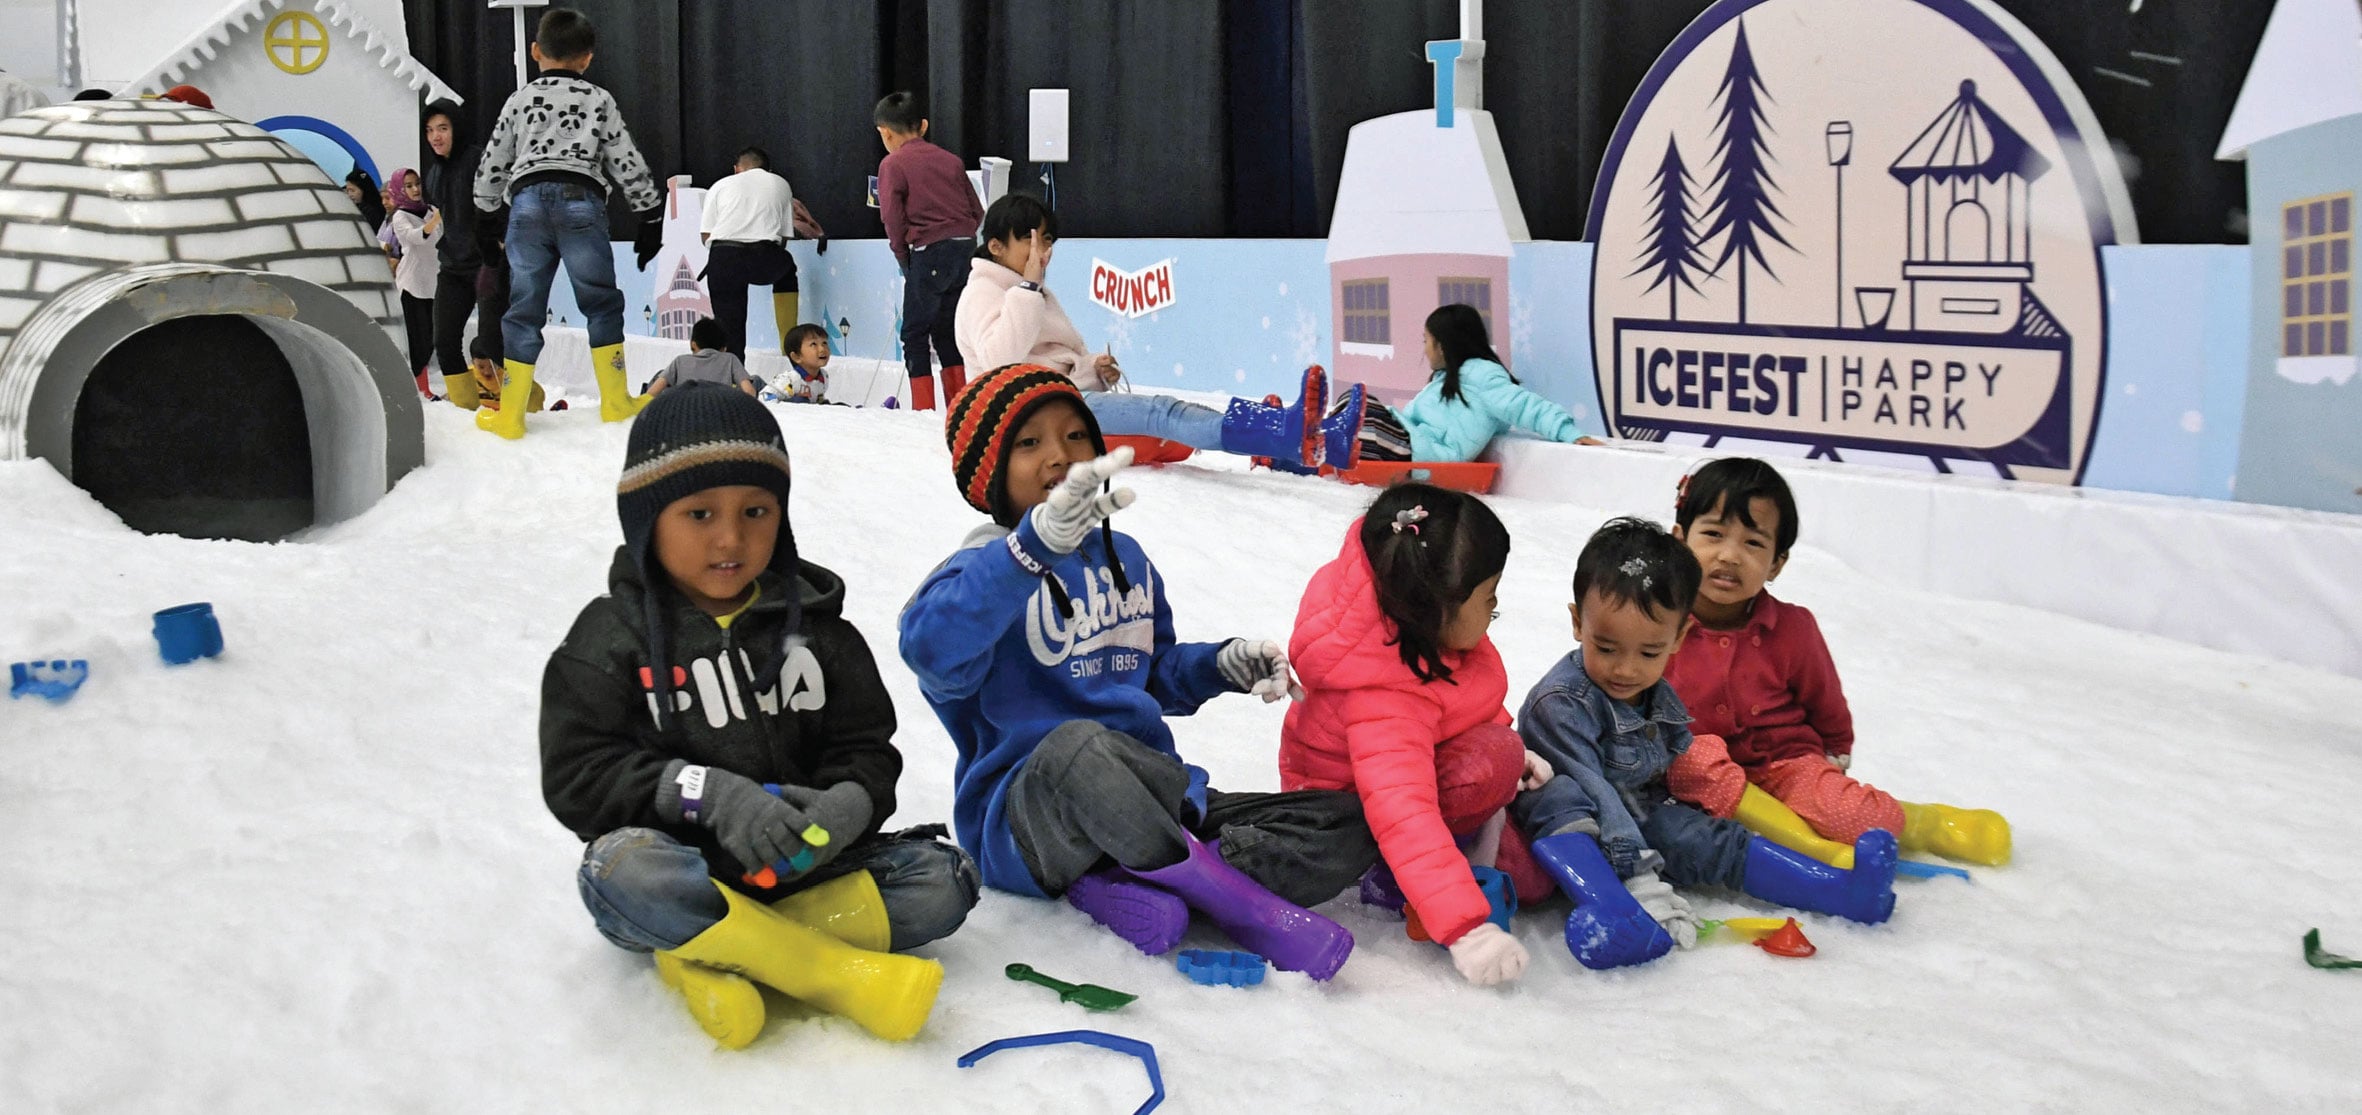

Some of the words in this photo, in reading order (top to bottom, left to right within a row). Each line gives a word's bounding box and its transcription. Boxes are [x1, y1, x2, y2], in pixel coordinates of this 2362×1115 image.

[1093, 265, 1171, 313] CRUNCH
[1635, 346, 1807, 417] ICEFEST
[1842, 355, 2002, 397] HAPPY
[1842, 390, 1966, 430] PARK
[1070, 657, 1103, 678] SINCE
[1111, 654, 1139, 672] 1895
